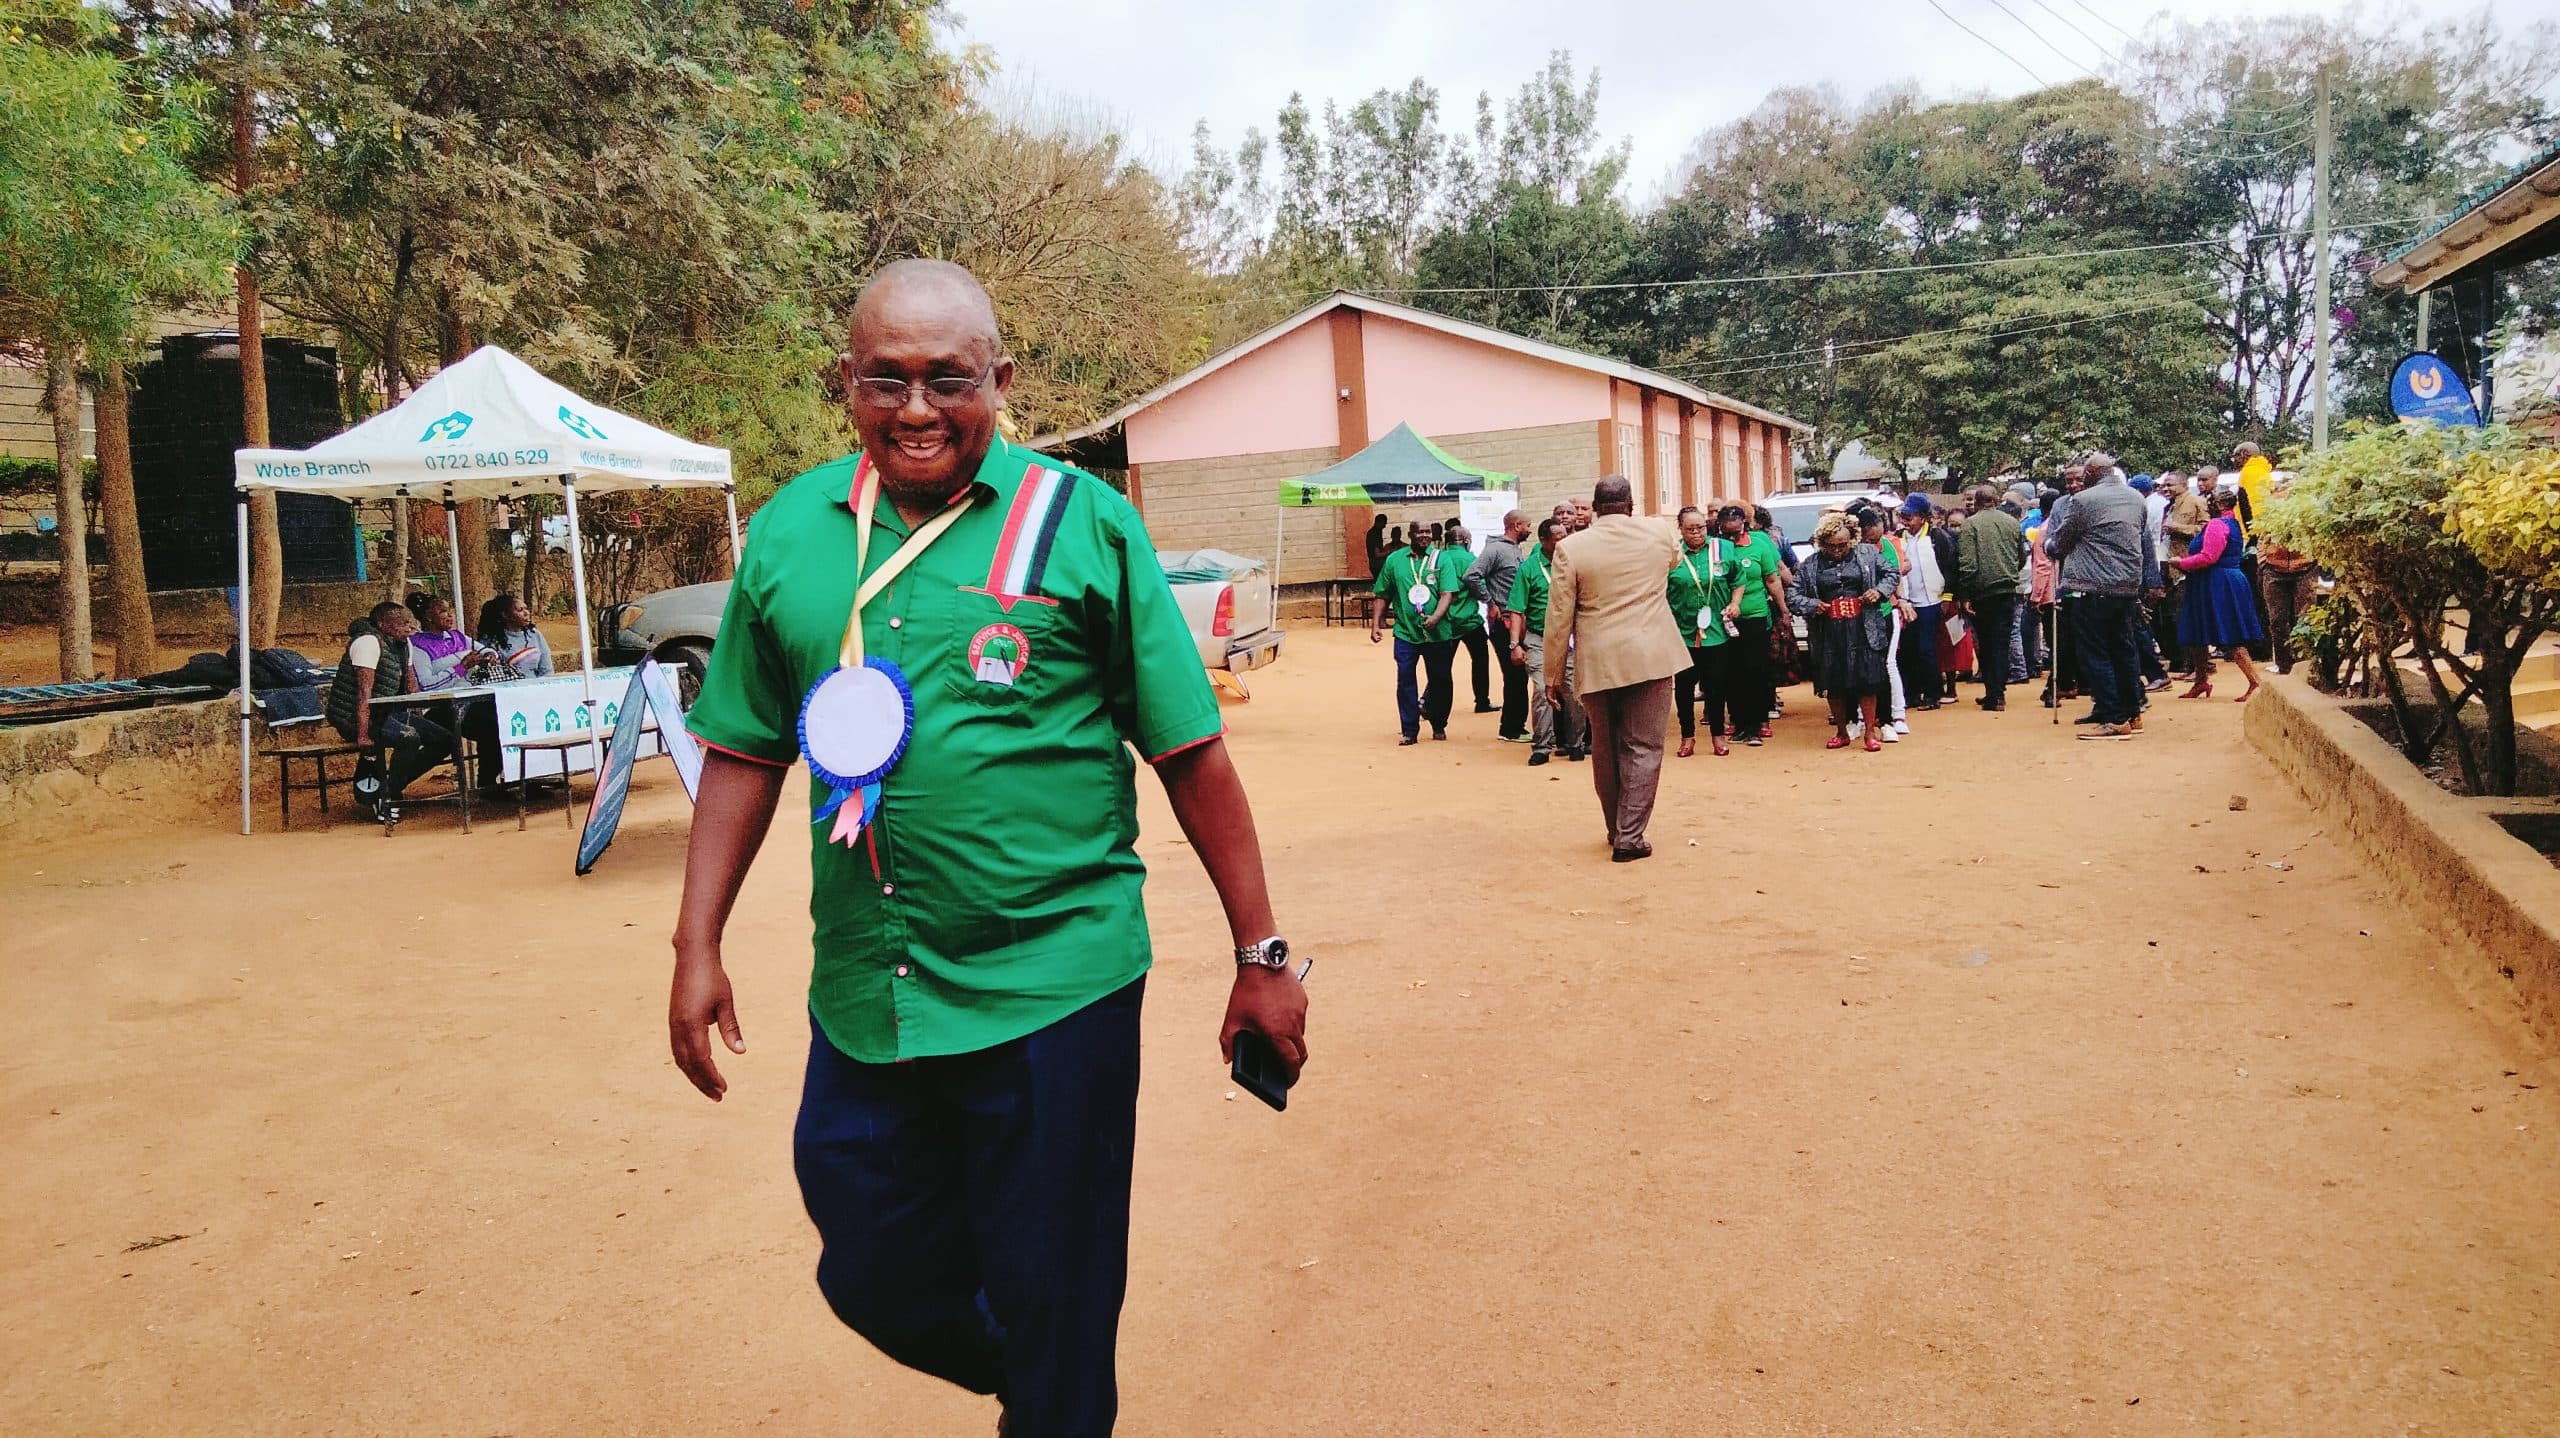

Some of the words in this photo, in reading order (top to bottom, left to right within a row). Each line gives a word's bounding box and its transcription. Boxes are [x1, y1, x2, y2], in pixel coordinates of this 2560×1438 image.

[255, 462, 300, 478] Wote
[304, 460, 371, 476] Branch
[425, 454, 471, 470] 0722
[474, 451, 508, 468] 840
[514, 449, 549, 466] 529
[1319, 487, 1347, 499] KCB
[1406, 484, 1448, 497] BANK
[971, 626, 997, 656] SERVICE
